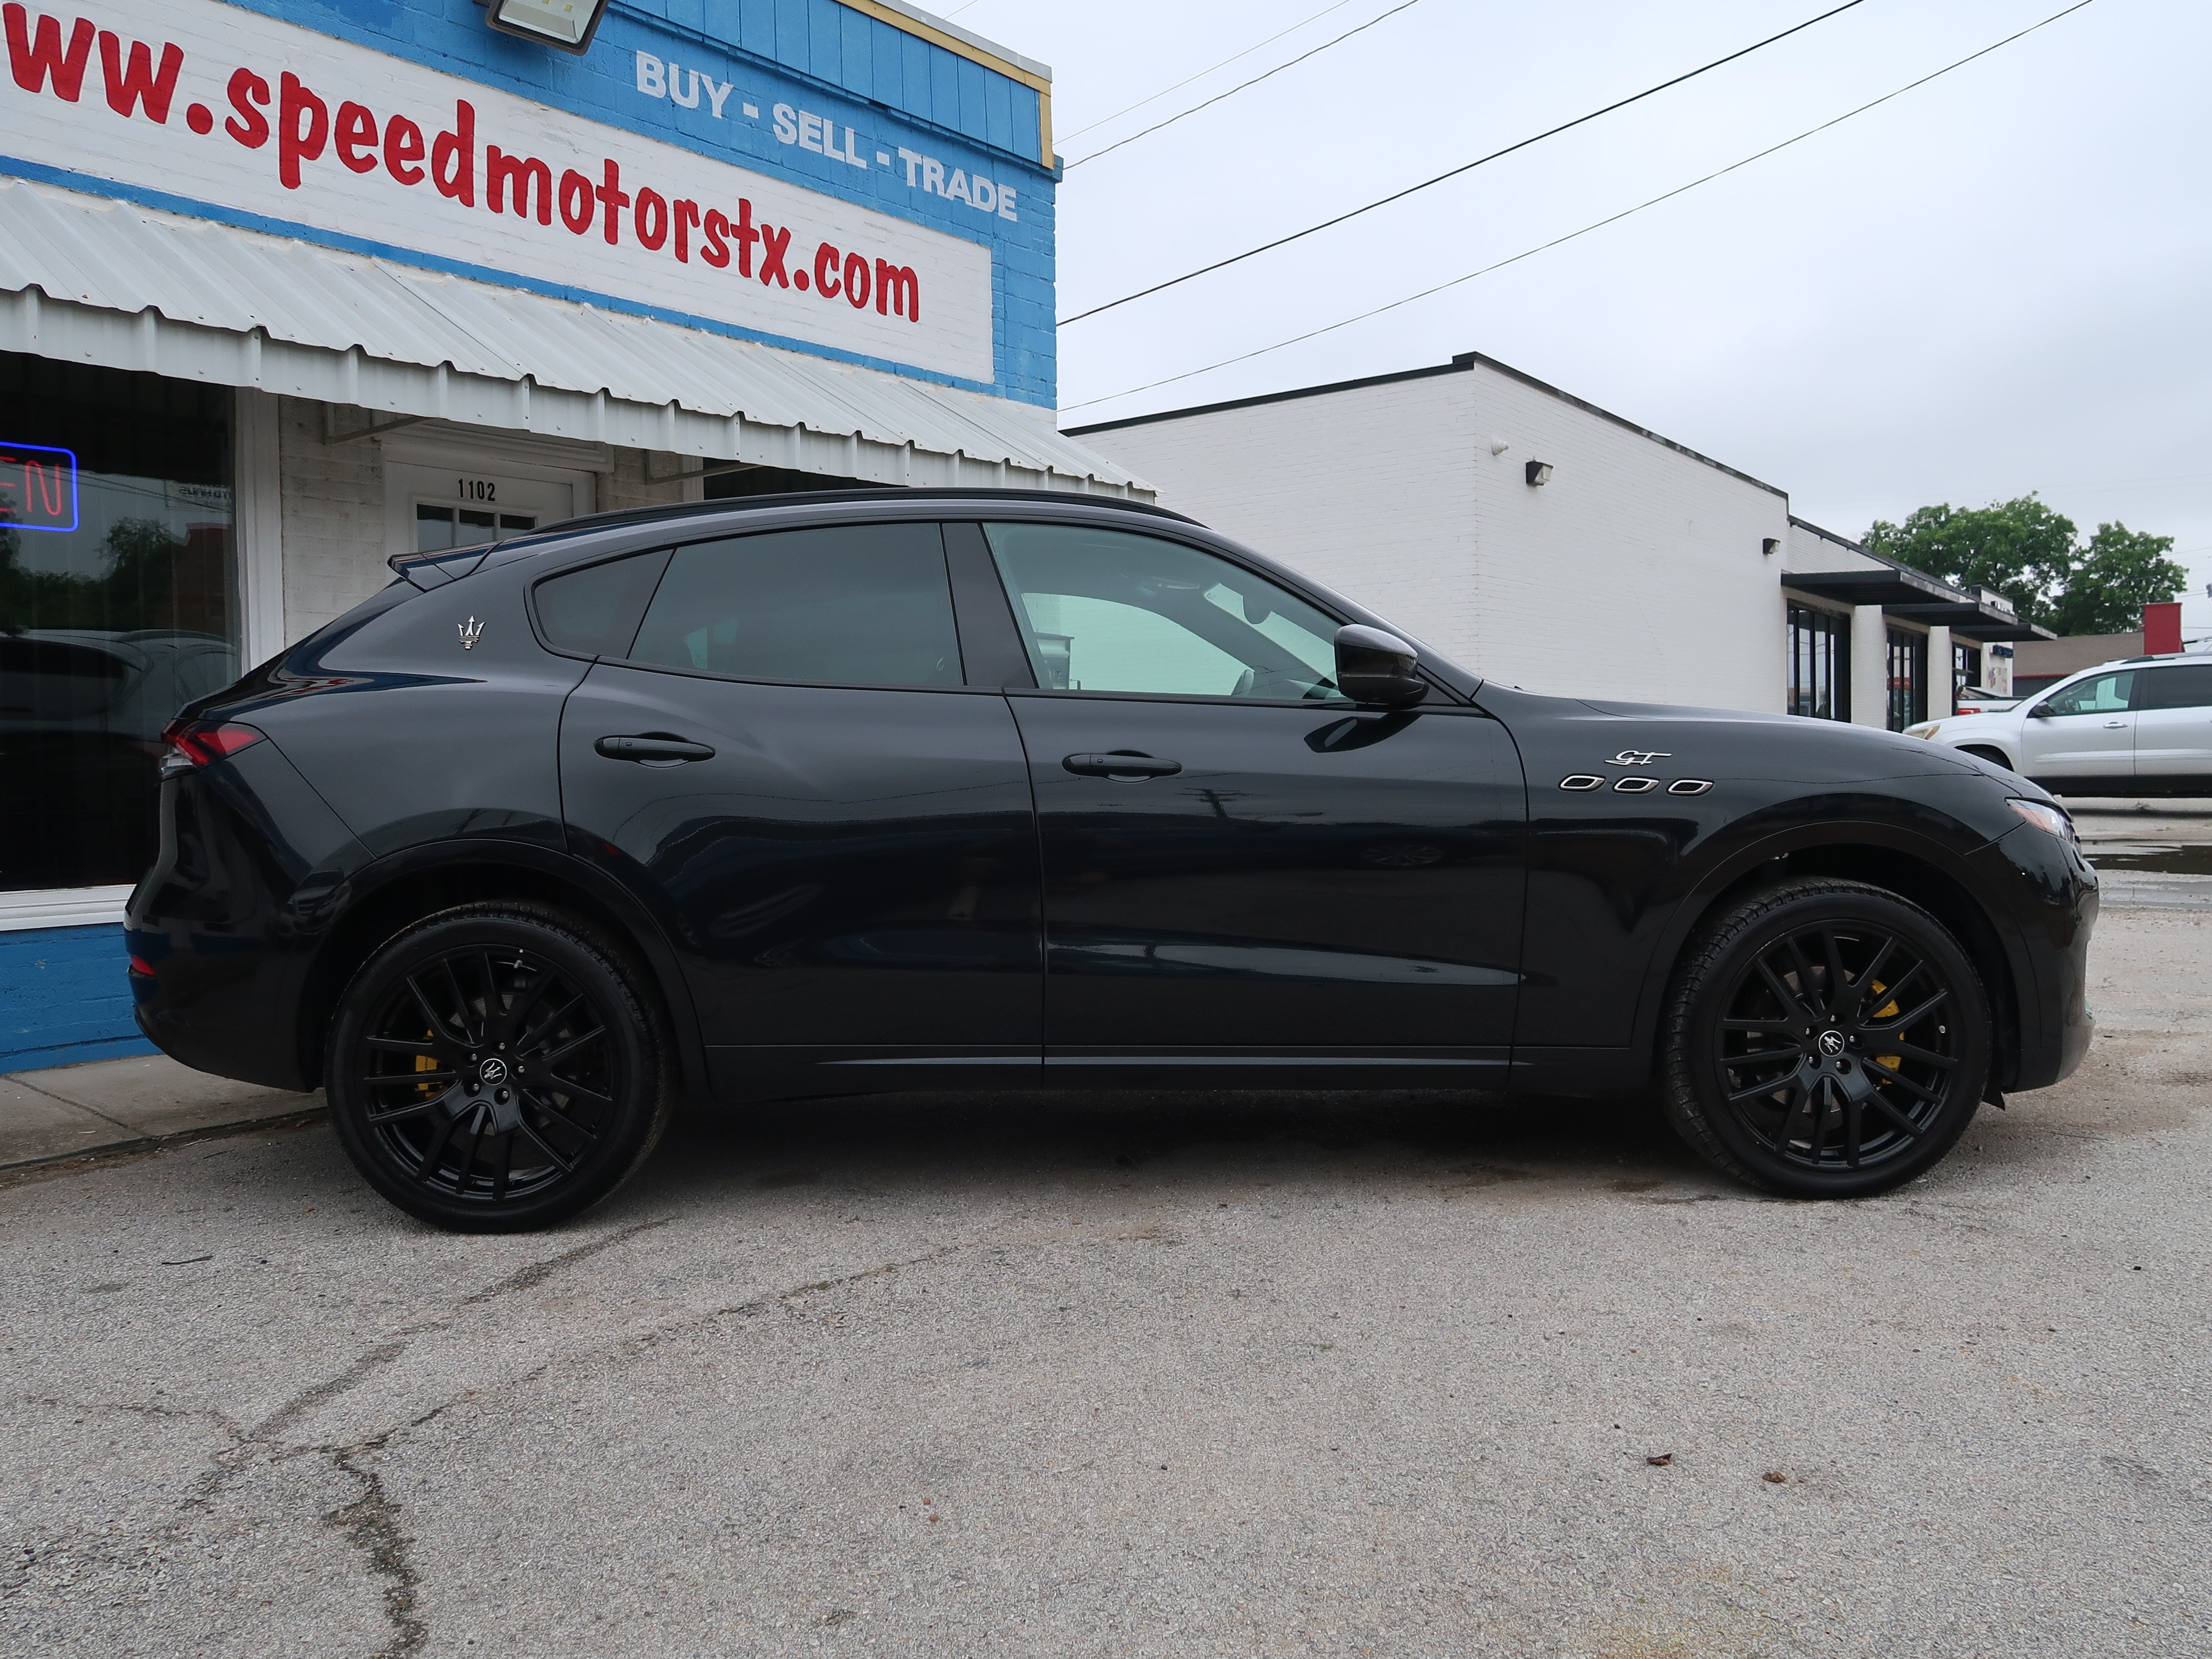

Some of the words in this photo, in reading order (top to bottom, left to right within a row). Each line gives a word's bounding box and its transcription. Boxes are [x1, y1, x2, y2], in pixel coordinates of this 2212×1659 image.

[3, 3, 919, 322] ww.speedmotorstx.com
[636, 50, 734, 119] BUY
[773, 103, 867, 169] SELL
[898, 146, 1017, 221] TRADE
[458, 478, 495, 501] 1102
[1604, 750, 1672, 765] GT
